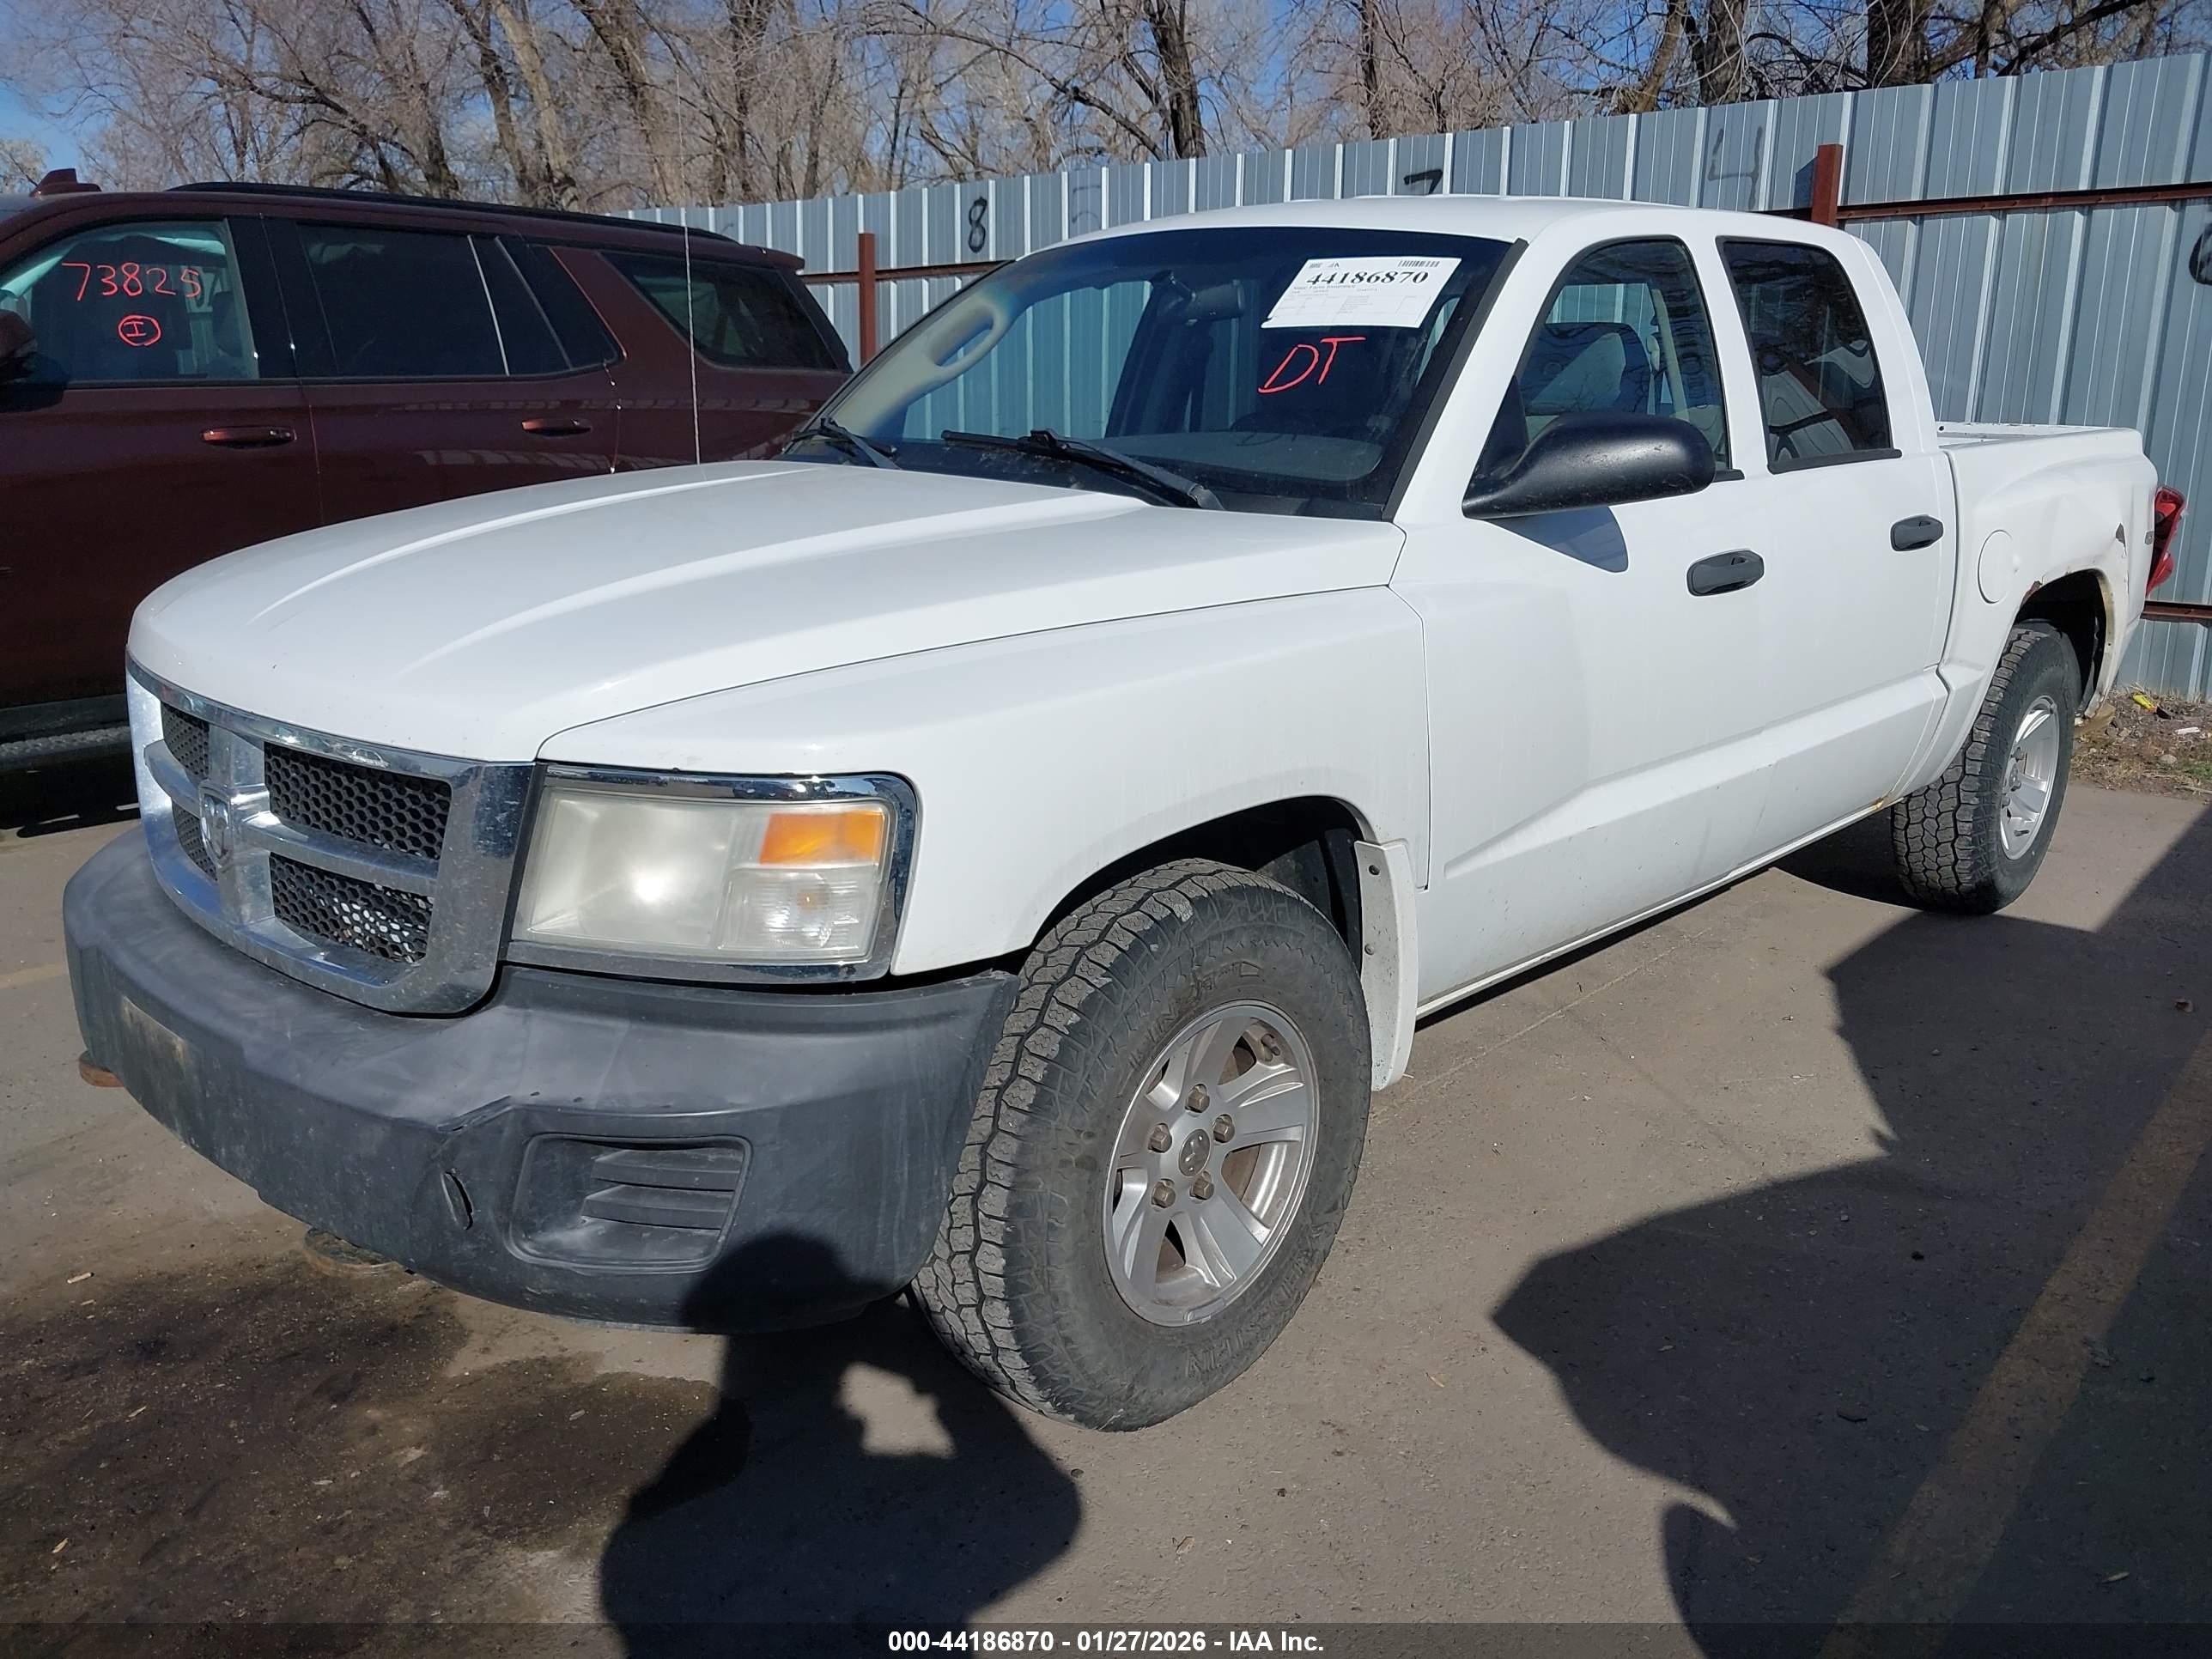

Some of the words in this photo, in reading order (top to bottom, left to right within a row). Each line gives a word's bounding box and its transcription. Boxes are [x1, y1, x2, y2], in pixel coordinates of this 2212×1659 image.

[968, 196, 988, 253] 8
[62, 261, 202, 301] 73825
[1306, 270, 1429, 286] 44186870
[1258, 336, 1366, 393] DT
